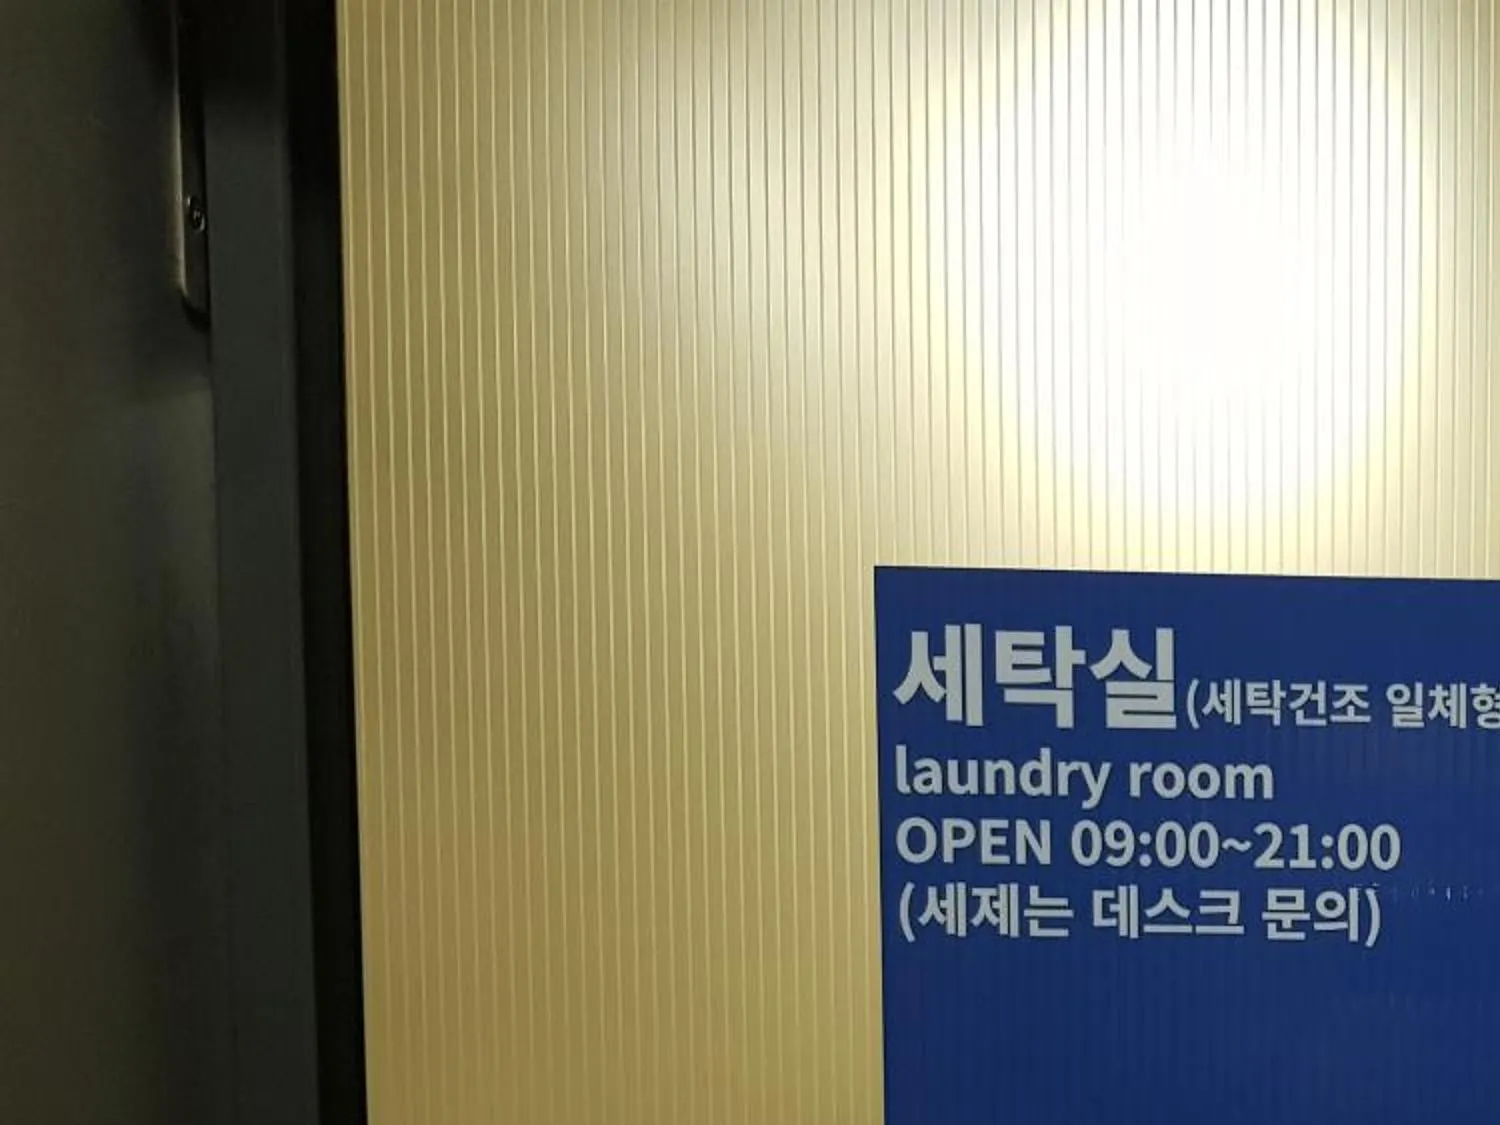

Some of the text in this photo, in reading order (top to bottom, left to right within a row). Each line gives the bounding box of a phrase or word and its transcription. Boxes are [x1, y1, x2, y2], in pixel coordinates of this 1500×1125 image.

[893, 623, 1177, 729] 세탁실
[1187, 678, 1371, 729] (세탁건조
[895, 745, 1274, 809] laundry room
[896, 817, 1401, 871] OPEN 09:00~21:00
[899, 882, 1381, 947] (세제는 데스크 문의)
